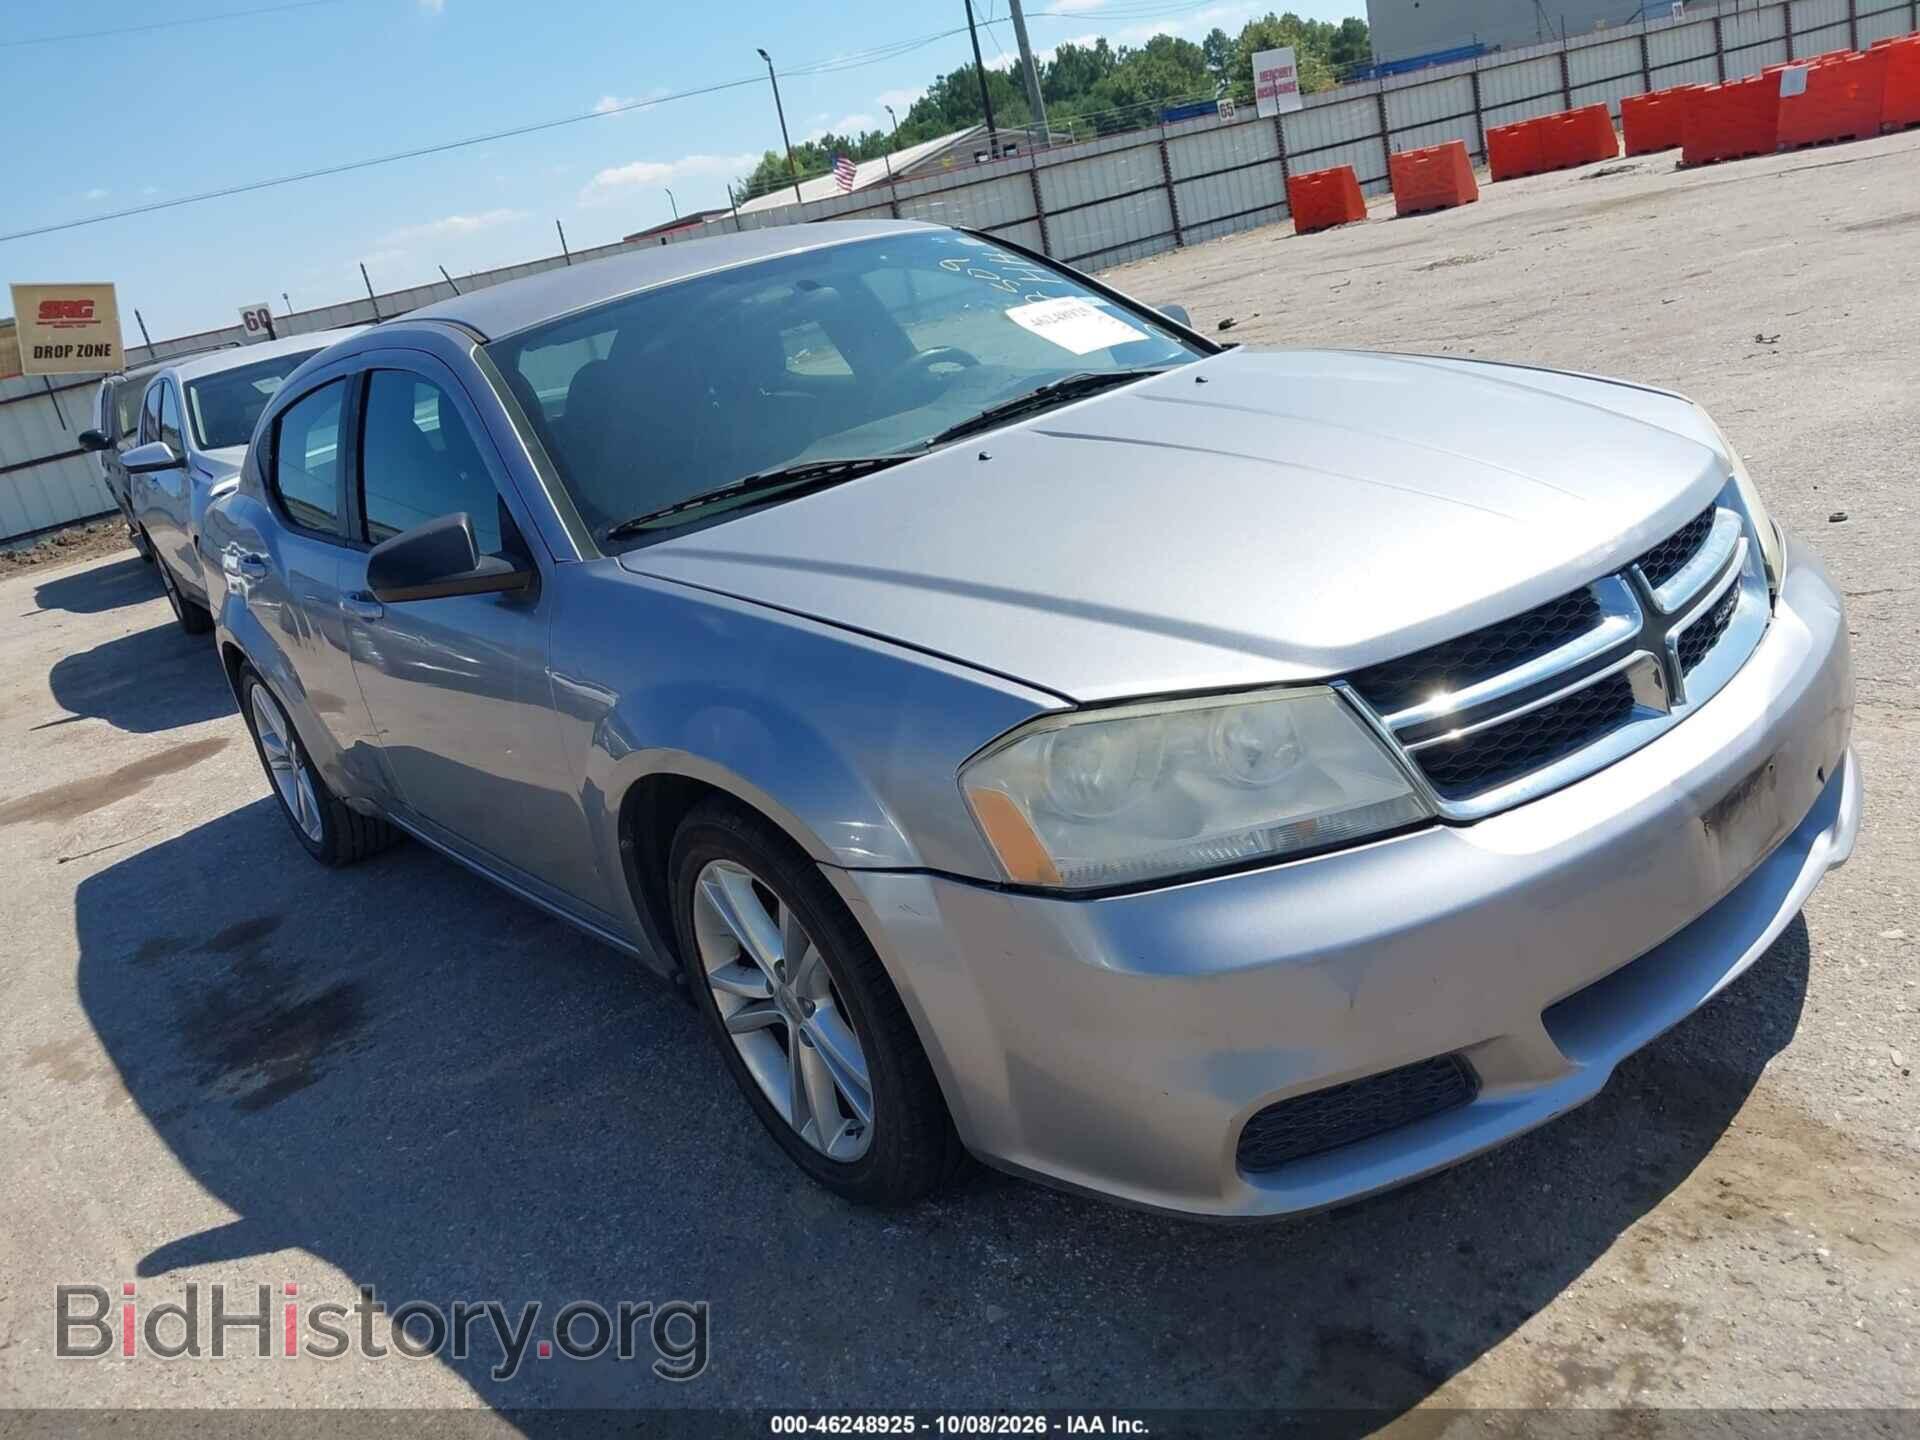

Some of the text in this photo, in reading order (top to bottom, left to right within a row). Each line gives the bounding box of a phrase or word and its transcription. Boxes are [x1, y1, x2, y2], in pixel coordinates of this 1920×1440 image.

[1220, 102, 1234, 119] 65
[243, 308, 271, 332] 60
[33, 343, 112, 359] DROP ZONE
